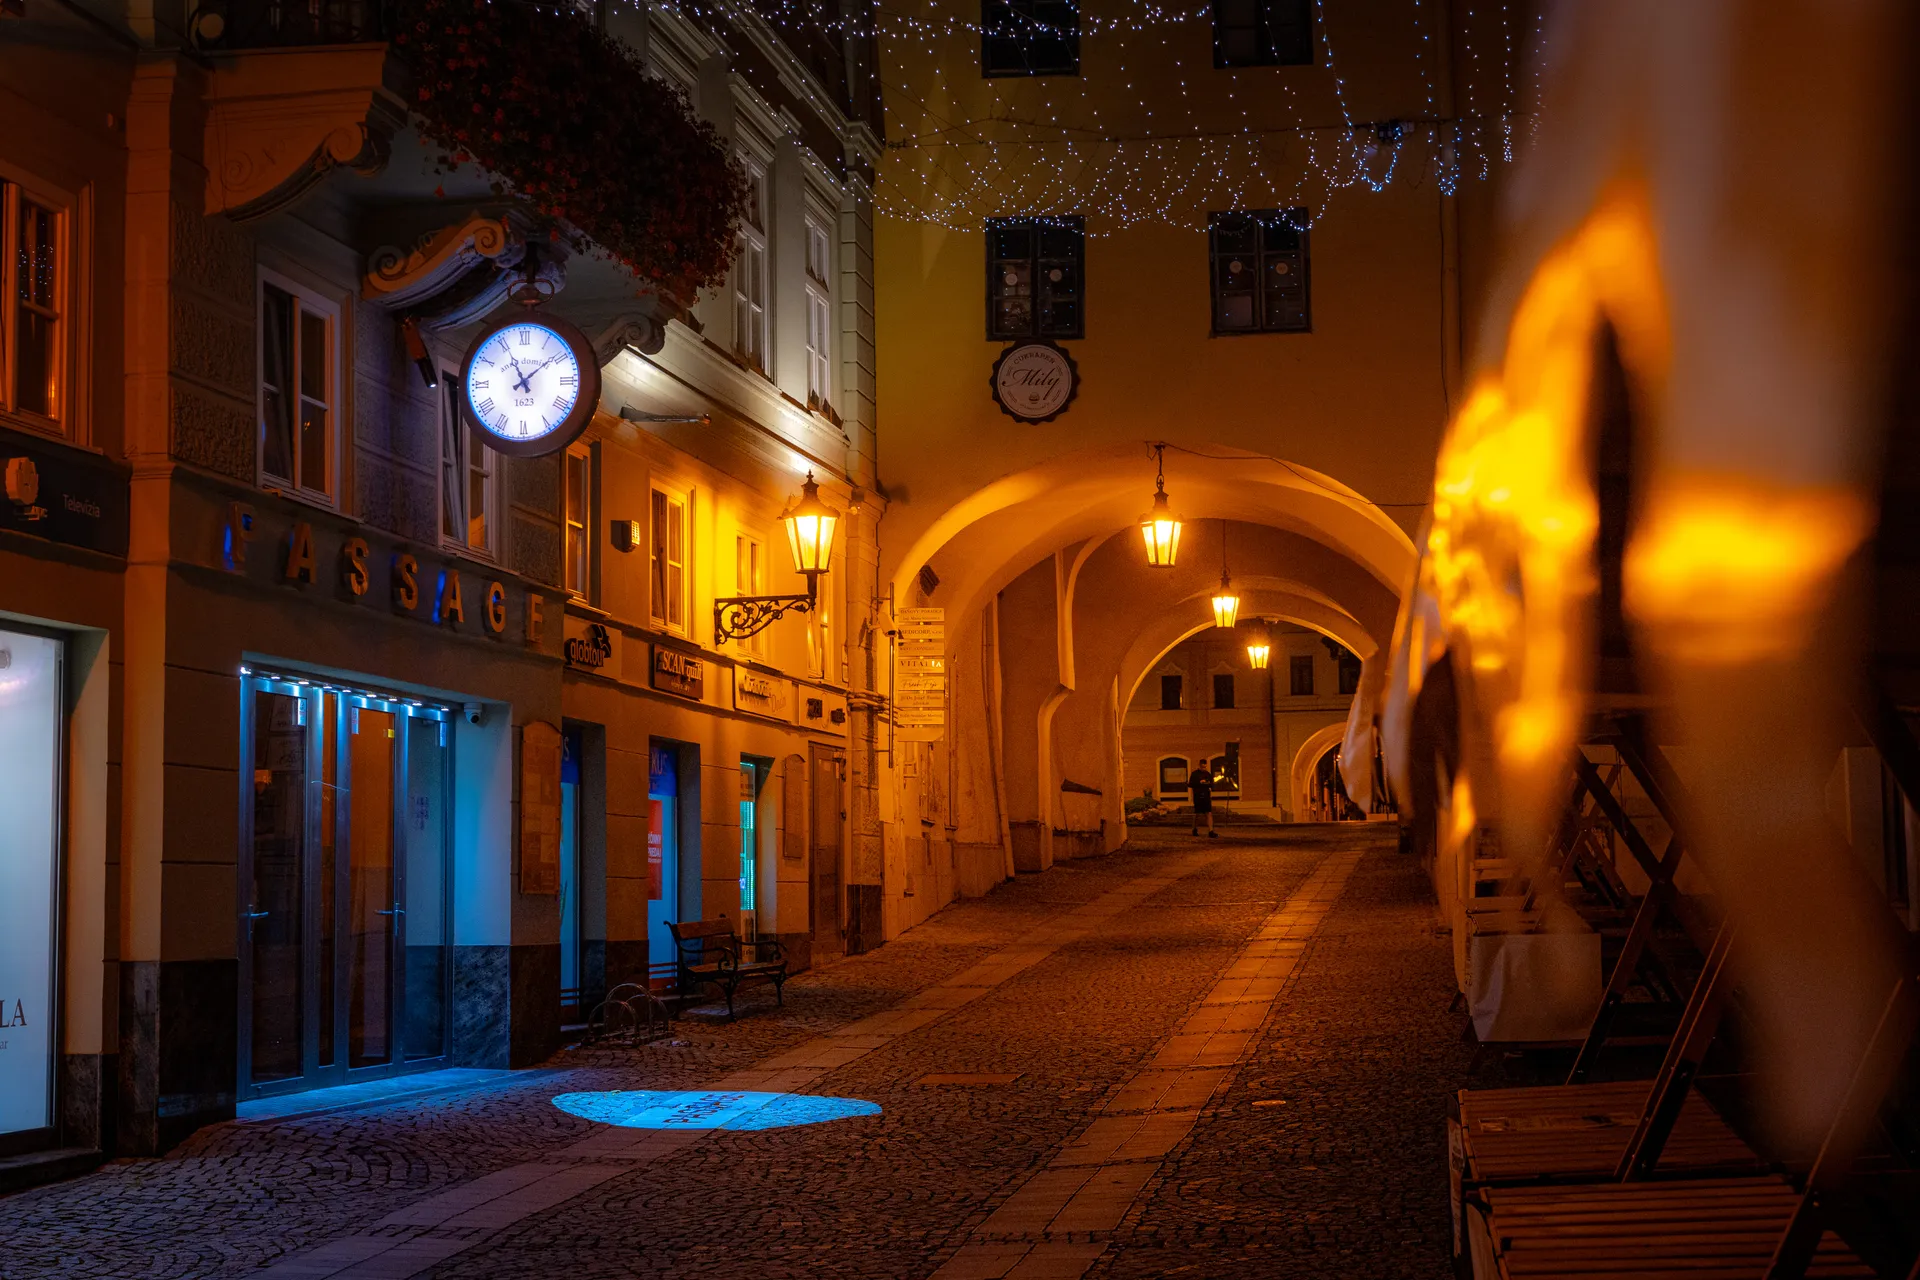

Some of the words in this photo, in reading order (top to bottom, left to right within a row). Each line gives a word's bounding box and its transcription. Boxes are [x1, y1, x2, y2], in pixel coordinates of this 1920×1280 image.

[1002, 368, 1060, 400] Mily
[514, 398, 534, 407] 1623
[230, 501, 545, 643] PASSAGE
[570, 638, 606, 667] globtour
[662, 650, 685, 675] SCAN
